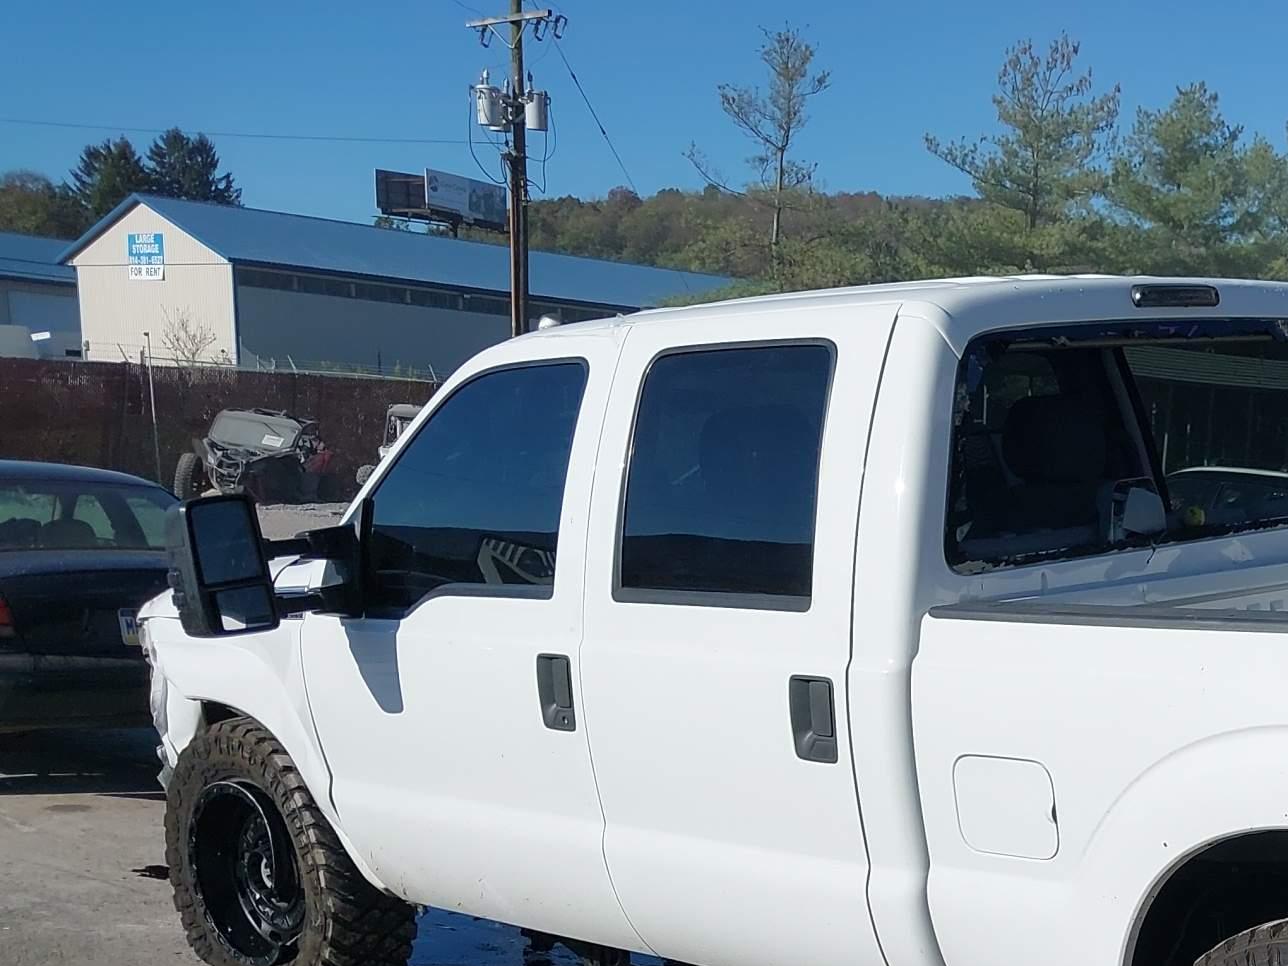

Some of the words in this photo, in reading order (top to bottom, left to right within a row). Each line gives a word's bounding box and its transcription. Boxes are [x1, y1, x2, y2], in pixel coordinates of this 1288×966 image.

[135, 234, 154, 243] LARGE
[132, 244, 159, 254] STORAGE
[130, 266, 143, 276] FOR
[145, 267, 161, 276] RENT
